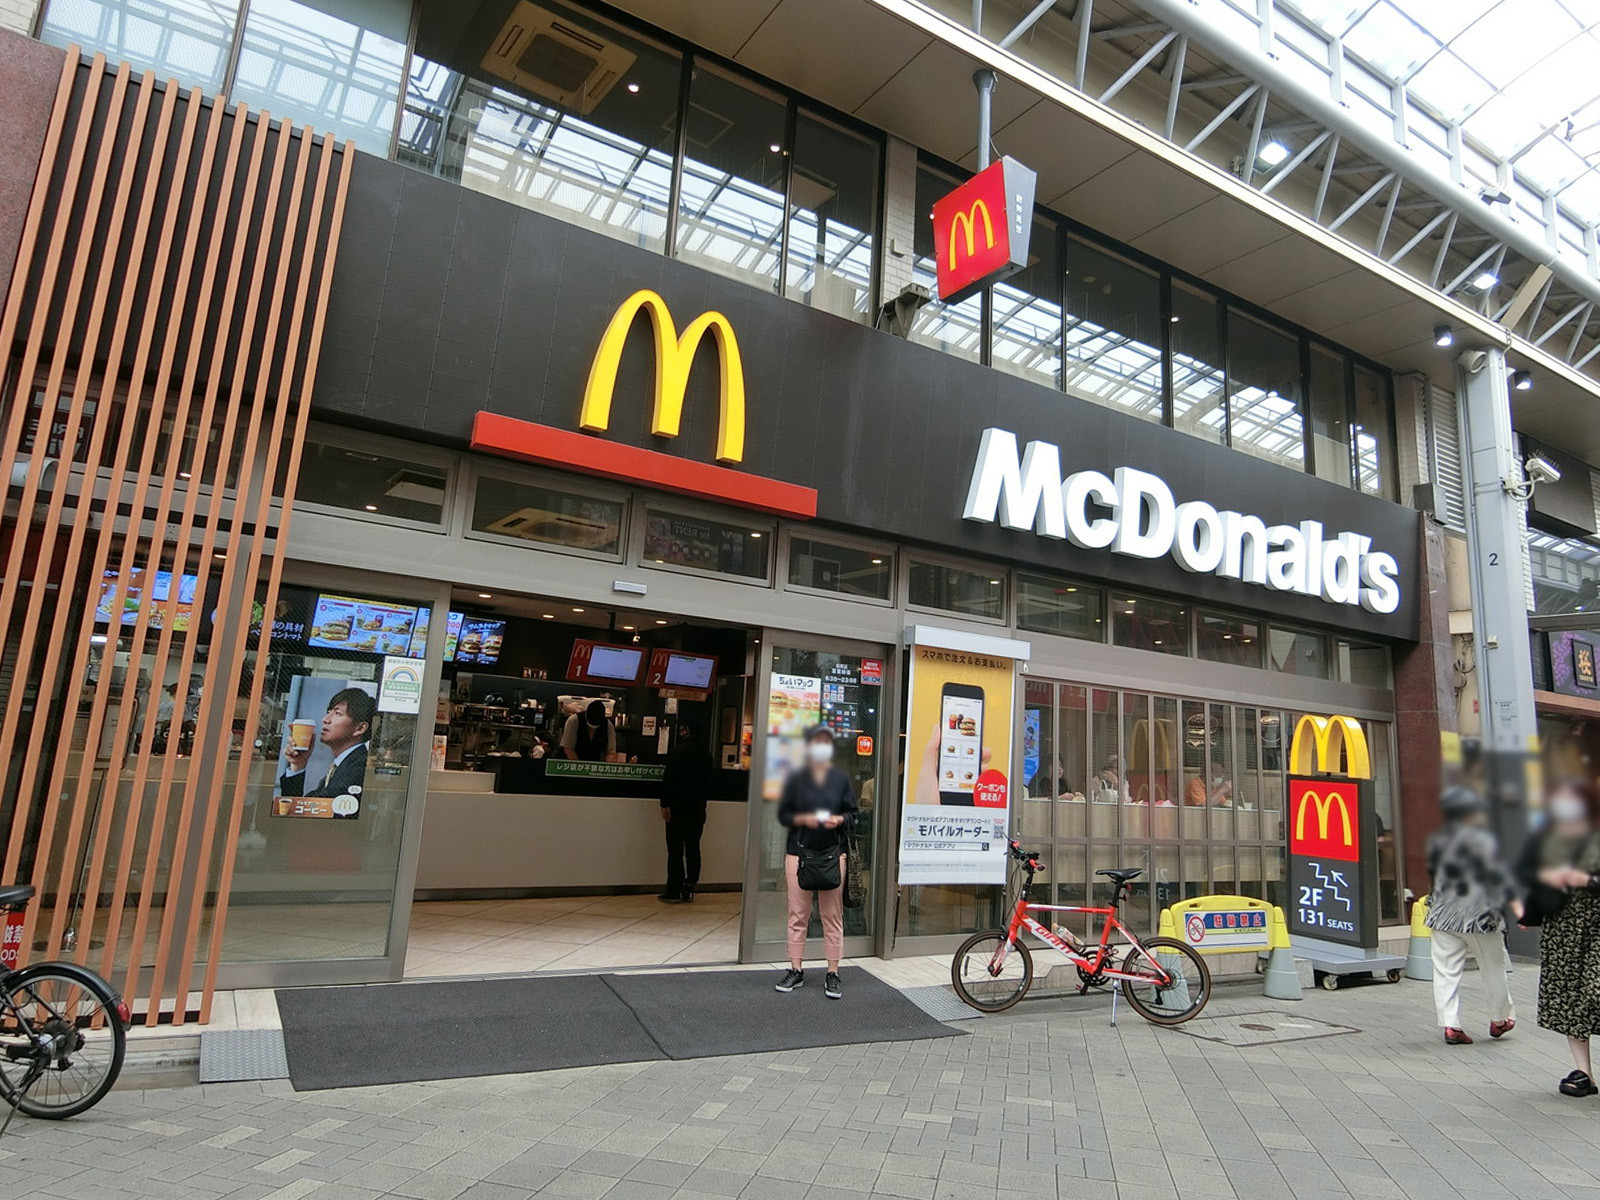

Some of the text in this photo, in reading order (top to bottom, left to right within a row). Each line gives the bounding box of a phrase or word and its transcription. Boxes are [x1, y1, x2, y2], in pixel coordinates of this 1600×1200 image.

[963, 428, 1400, 615] McDonald's
[1489, 553, 1499, 566] 2
[575, 665, 582, 677] 1
[653, 673, 662, 685] 2
[295, 805, 328, 814] コーヒー
[918, 825, 990, 838] モバイルオーダー
[1299, 886, 1323, 906] 2F
[1298, 908, 1354, 931] 131 SEATS
